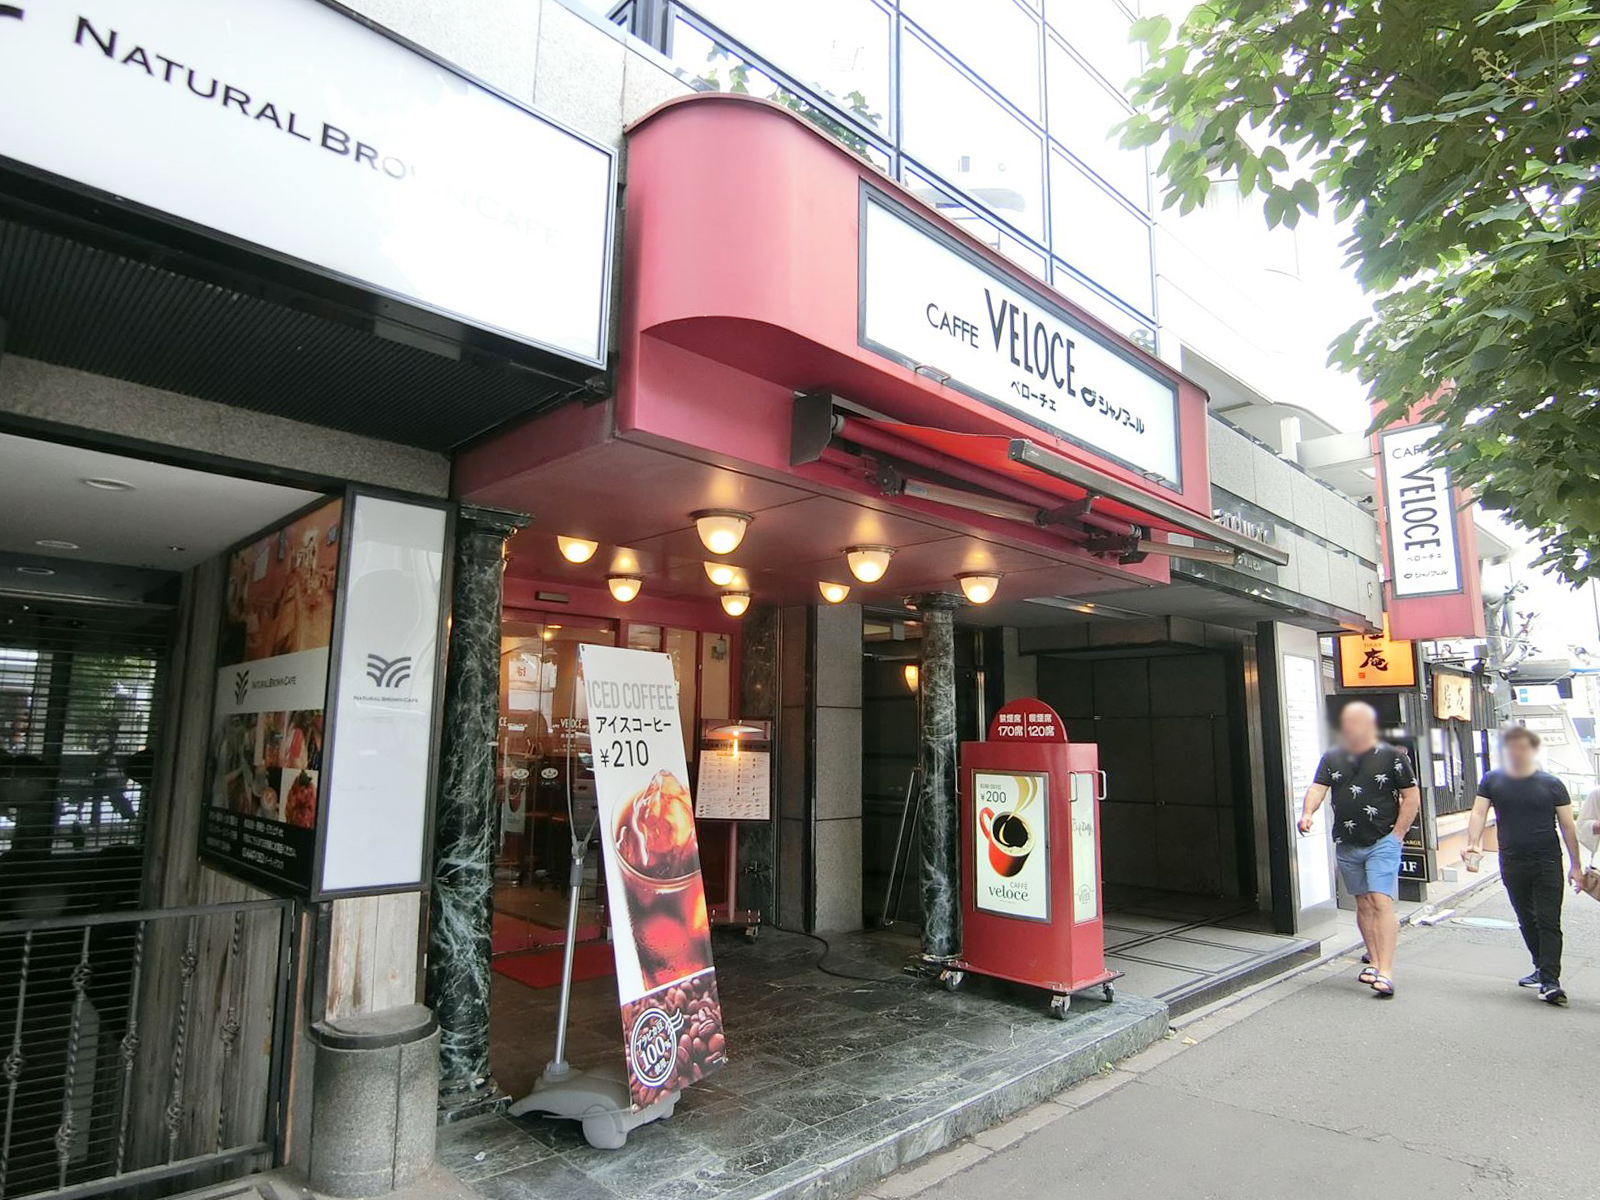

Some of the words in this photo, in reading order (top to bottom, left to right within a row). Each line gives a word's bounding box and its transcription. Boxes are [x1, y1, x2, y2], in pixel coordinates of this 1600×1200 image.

[74, 16, 311, 142] NATURAL
[926, 303, 979, 349] CAFFE
[984, 288, 1077, 398] VELOCE
[1011, 380, 1057, 412] ベローチェ
[1099, 395, 1145, 434] シャノアール
[1399, 460, 1441, 551] VELOCE
[588, 680, 619, 709] ICED
[624, 683, 675, 711] COFFEE
[596, 716, 672, 733] アイスコーヒー
[998, 725, 1024, 737] 170席
[1028, 725, 1055, 737] 120席
[600, 740, 649, 767] ¥210
[981, 790, 1007, 804] ¥200
[1400, 861, 1418, 873] 1F
[988, 884, 1030, 902] veloce
